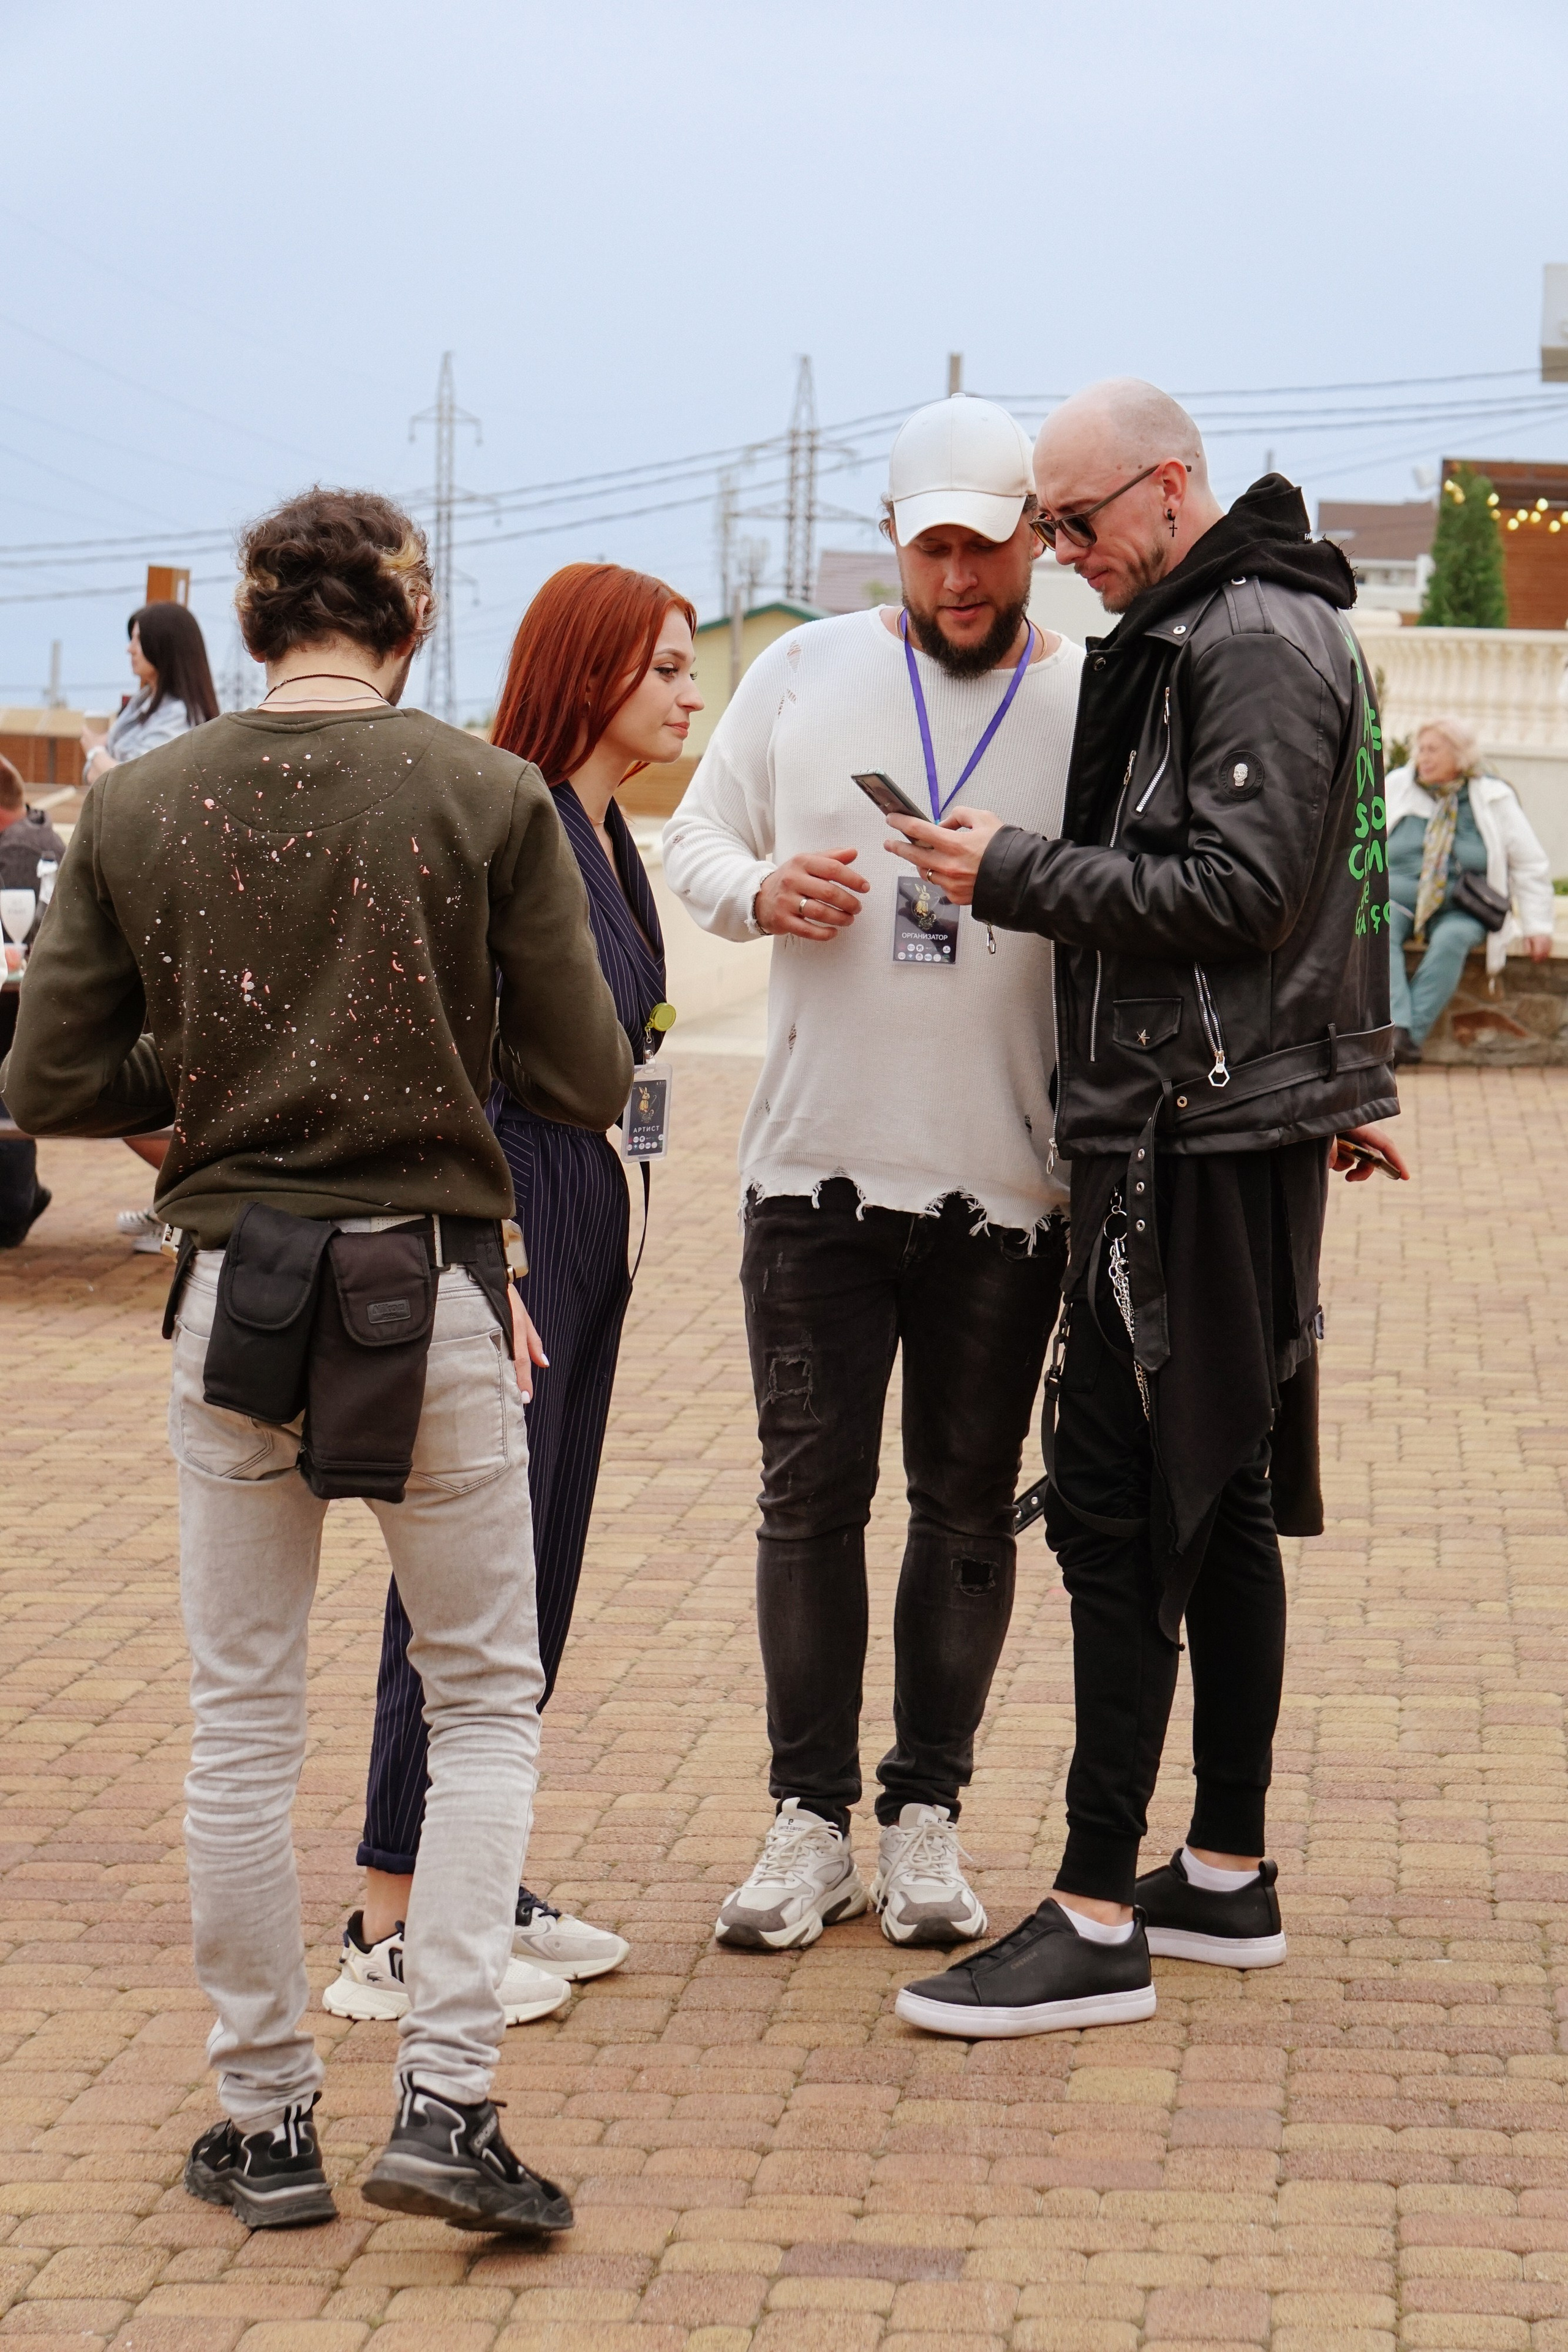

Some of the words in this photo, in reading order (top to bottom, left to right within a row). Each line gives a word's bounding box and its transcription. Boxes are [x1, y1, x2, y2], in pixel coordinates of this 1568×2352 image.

[902, 932, 948, 941] ОРГАНИЗАТОР
[633, 1125, 660, 1134] АРТИСТ
[372, 1303, 405, 1315] Nikon
